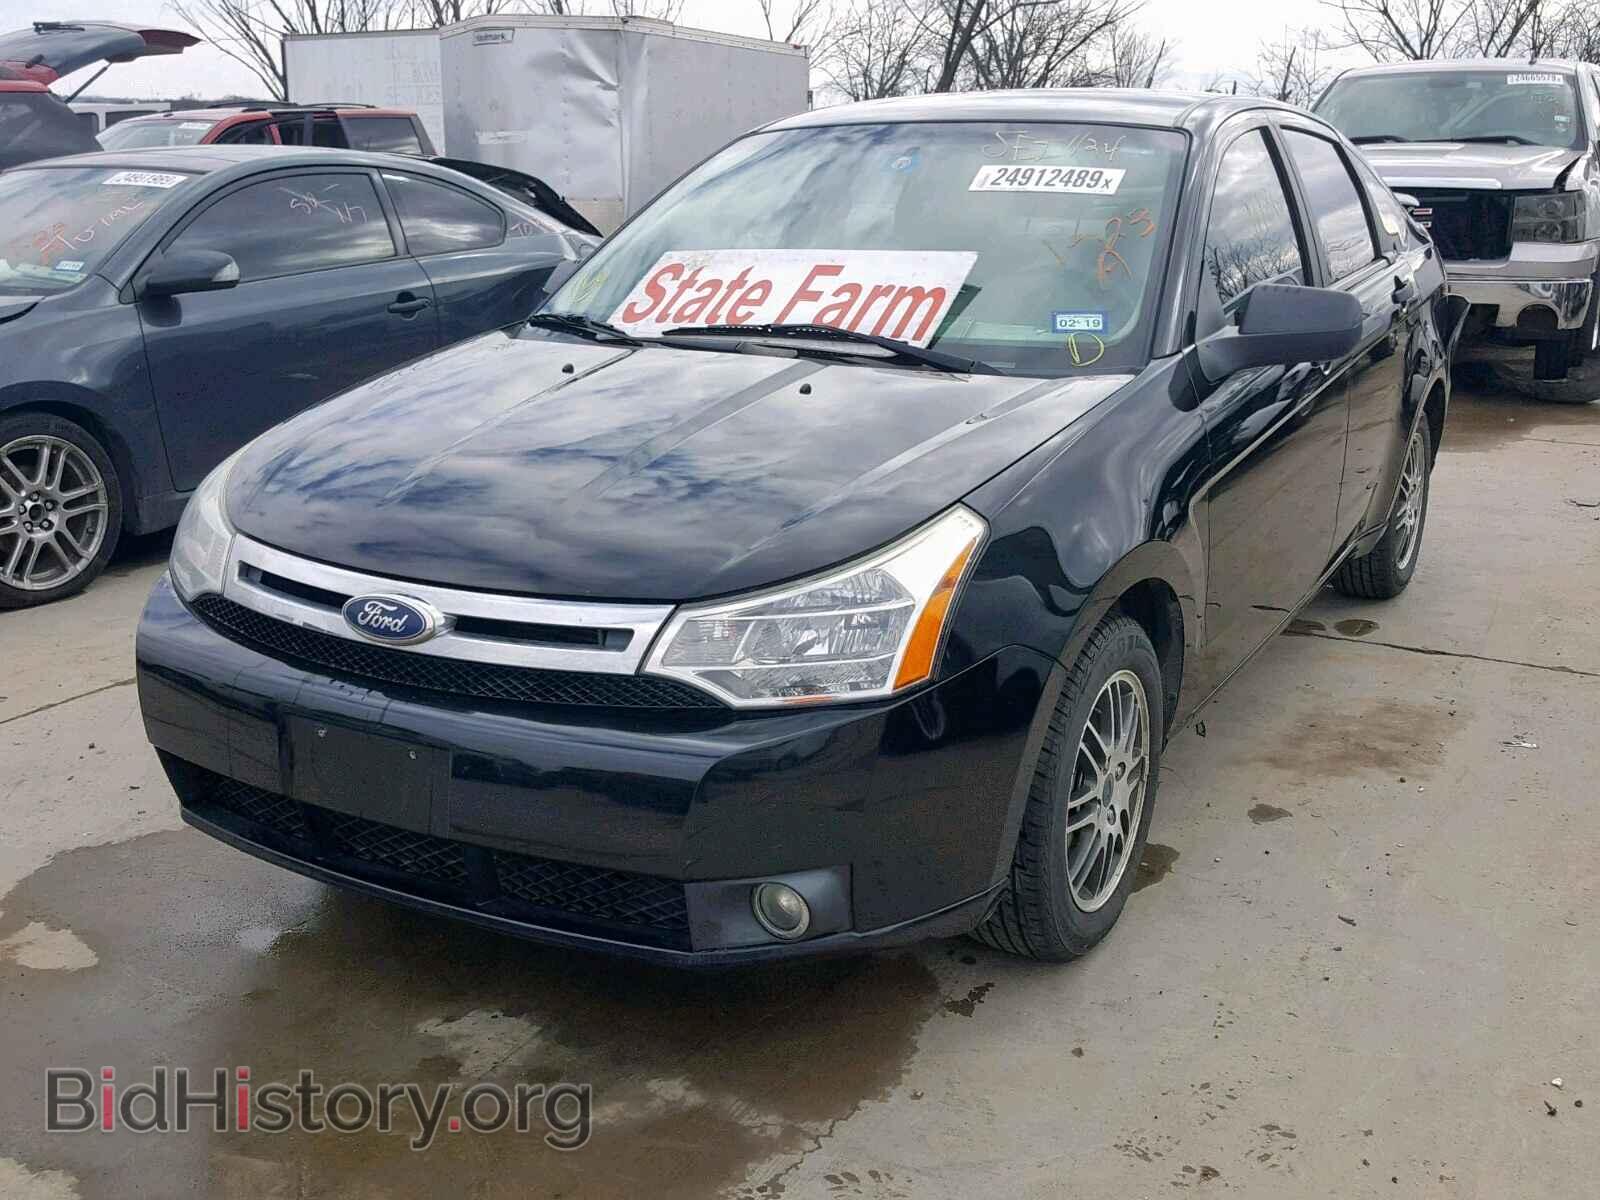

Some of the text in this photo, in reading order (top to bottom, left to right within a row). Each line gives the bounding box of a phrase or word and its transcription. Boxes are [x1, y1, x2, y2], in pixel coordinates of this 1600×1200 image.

[622, 262, 773, 326] State
[775, 264, 947, 341] Farm
[357, 600, 409, 633] Ford
